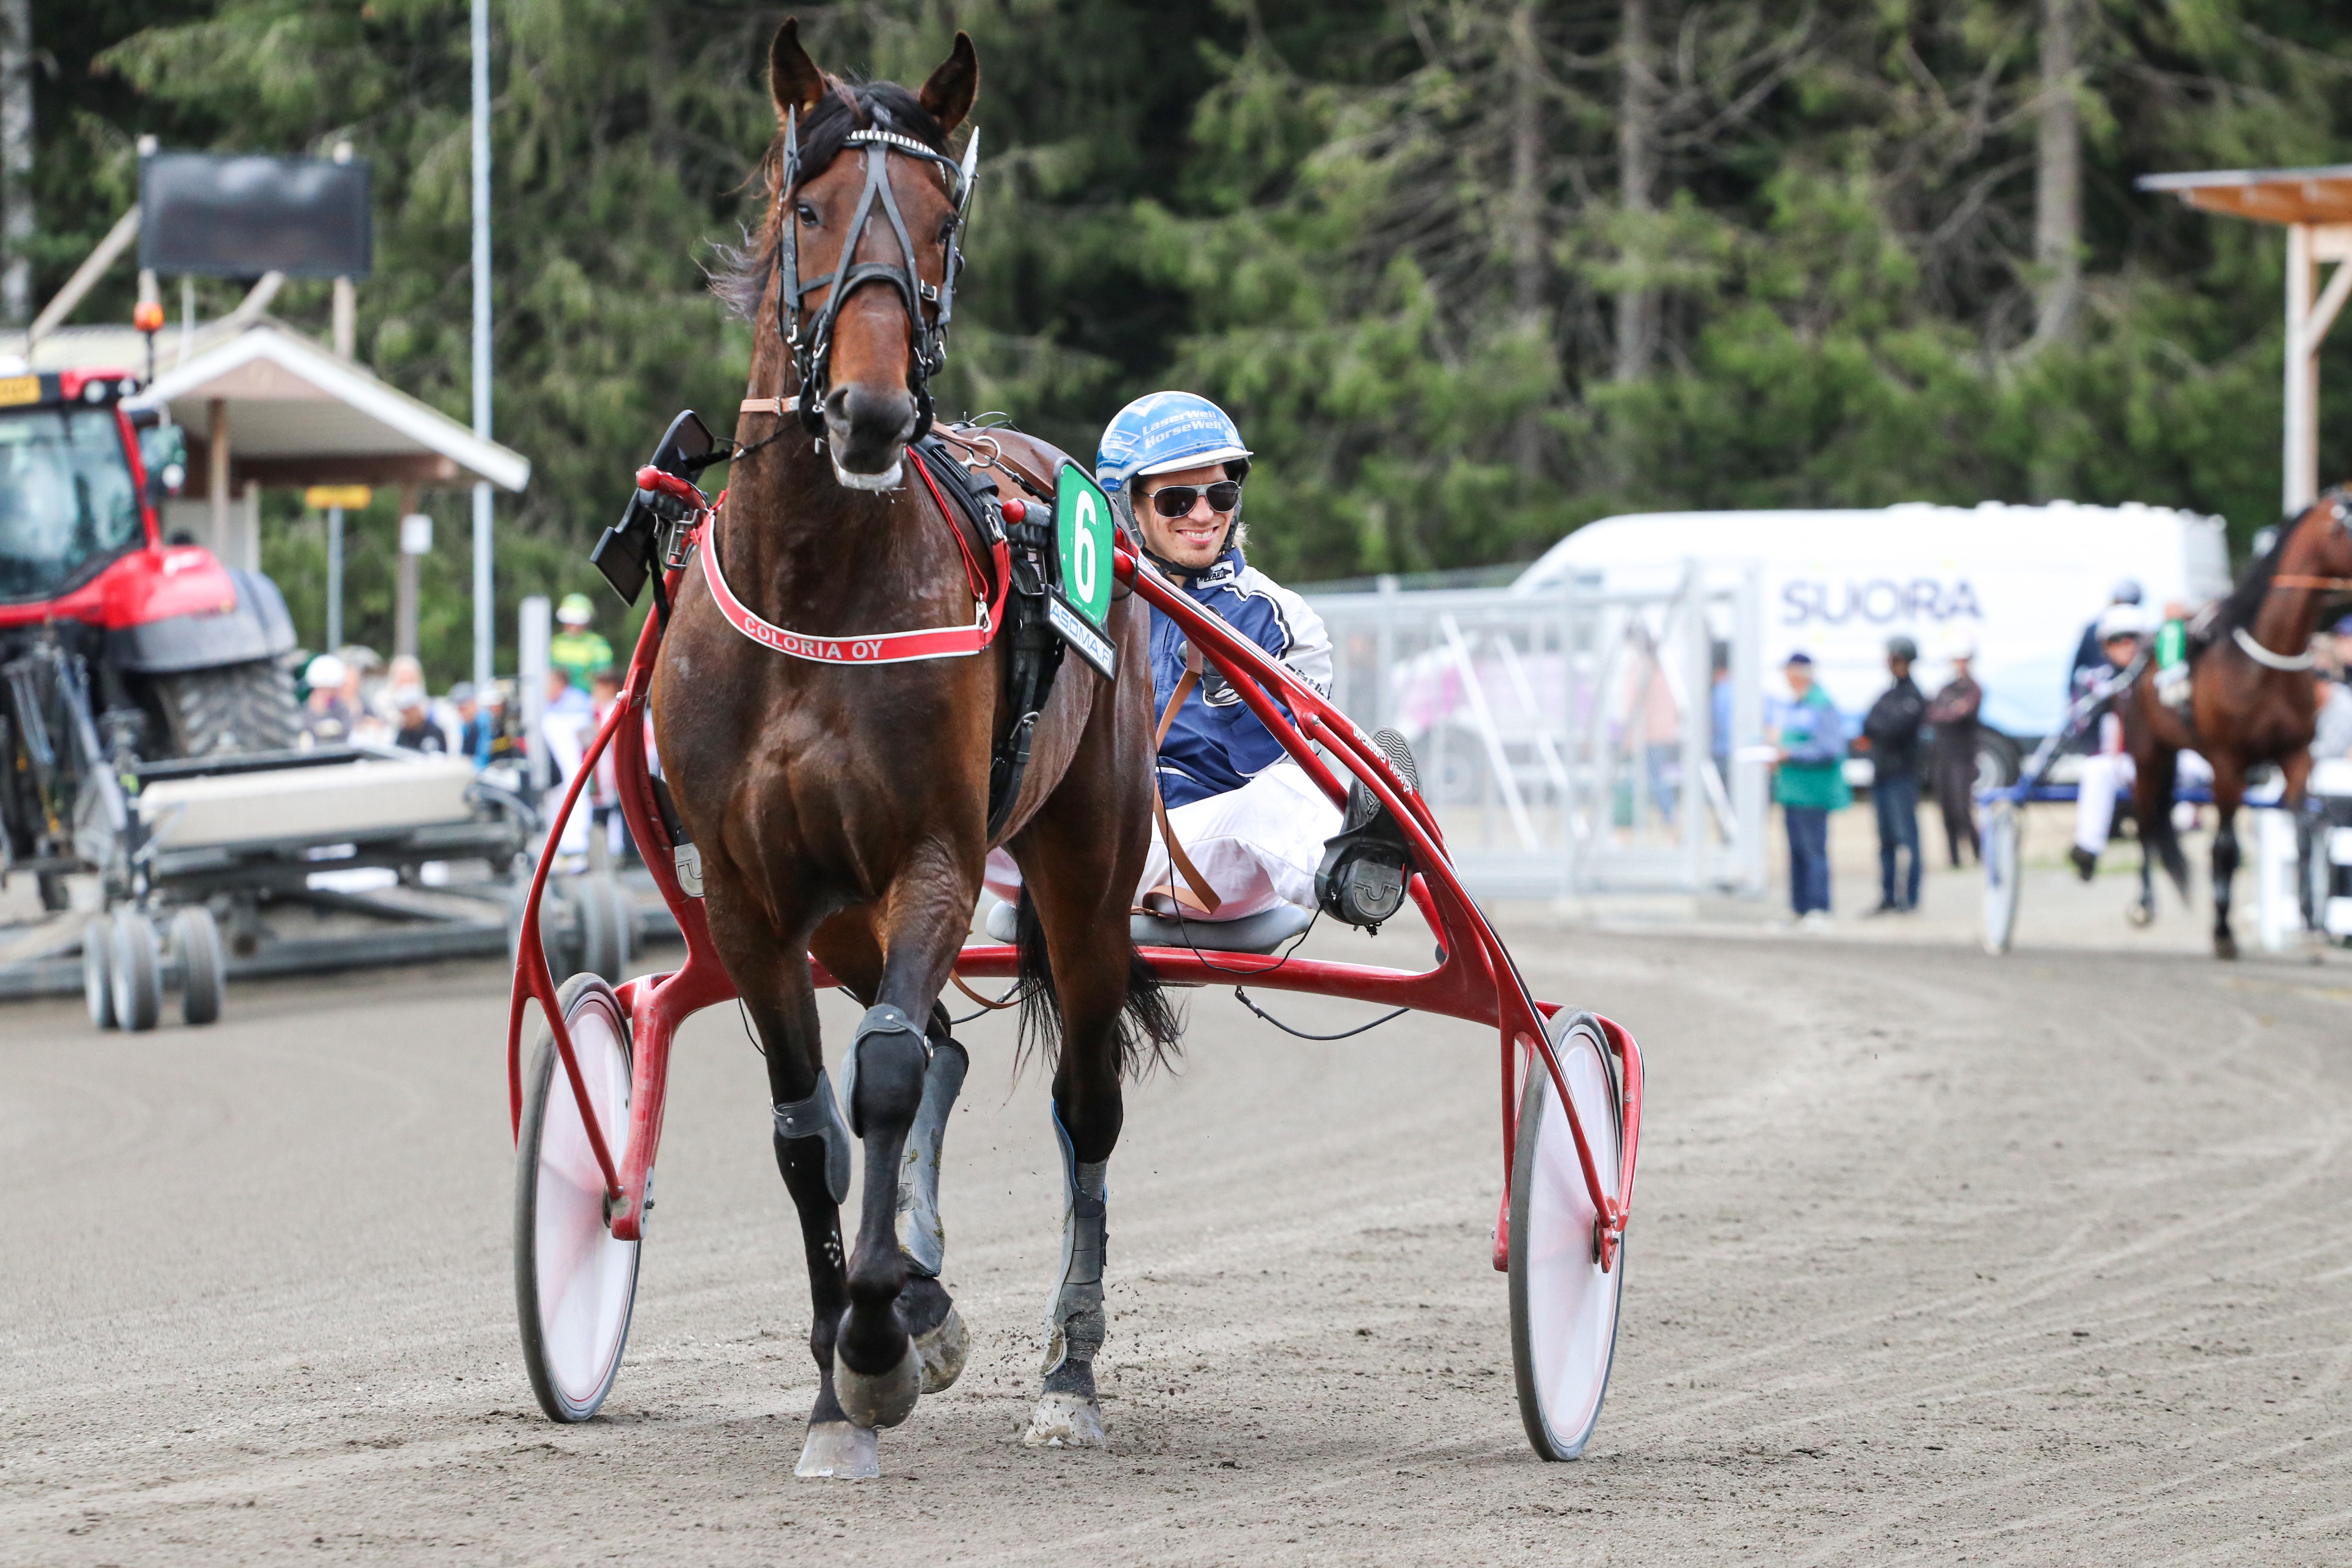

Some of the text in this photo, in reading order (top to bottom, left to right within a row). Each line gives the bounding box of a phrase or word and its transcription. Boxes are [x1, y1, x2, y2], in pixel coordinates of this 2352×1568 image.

[1142, 410, 1217, 436] LaserWell
[1145, 420, 1222, 449] HorseWell
[1073, 489, 1096, 603] 6
[1779, 579, 1985, 626] SUORA
[744, 616, 883, 659] COLORIA OY
[1050, 603, 1112, 669] ASOMA.FI
